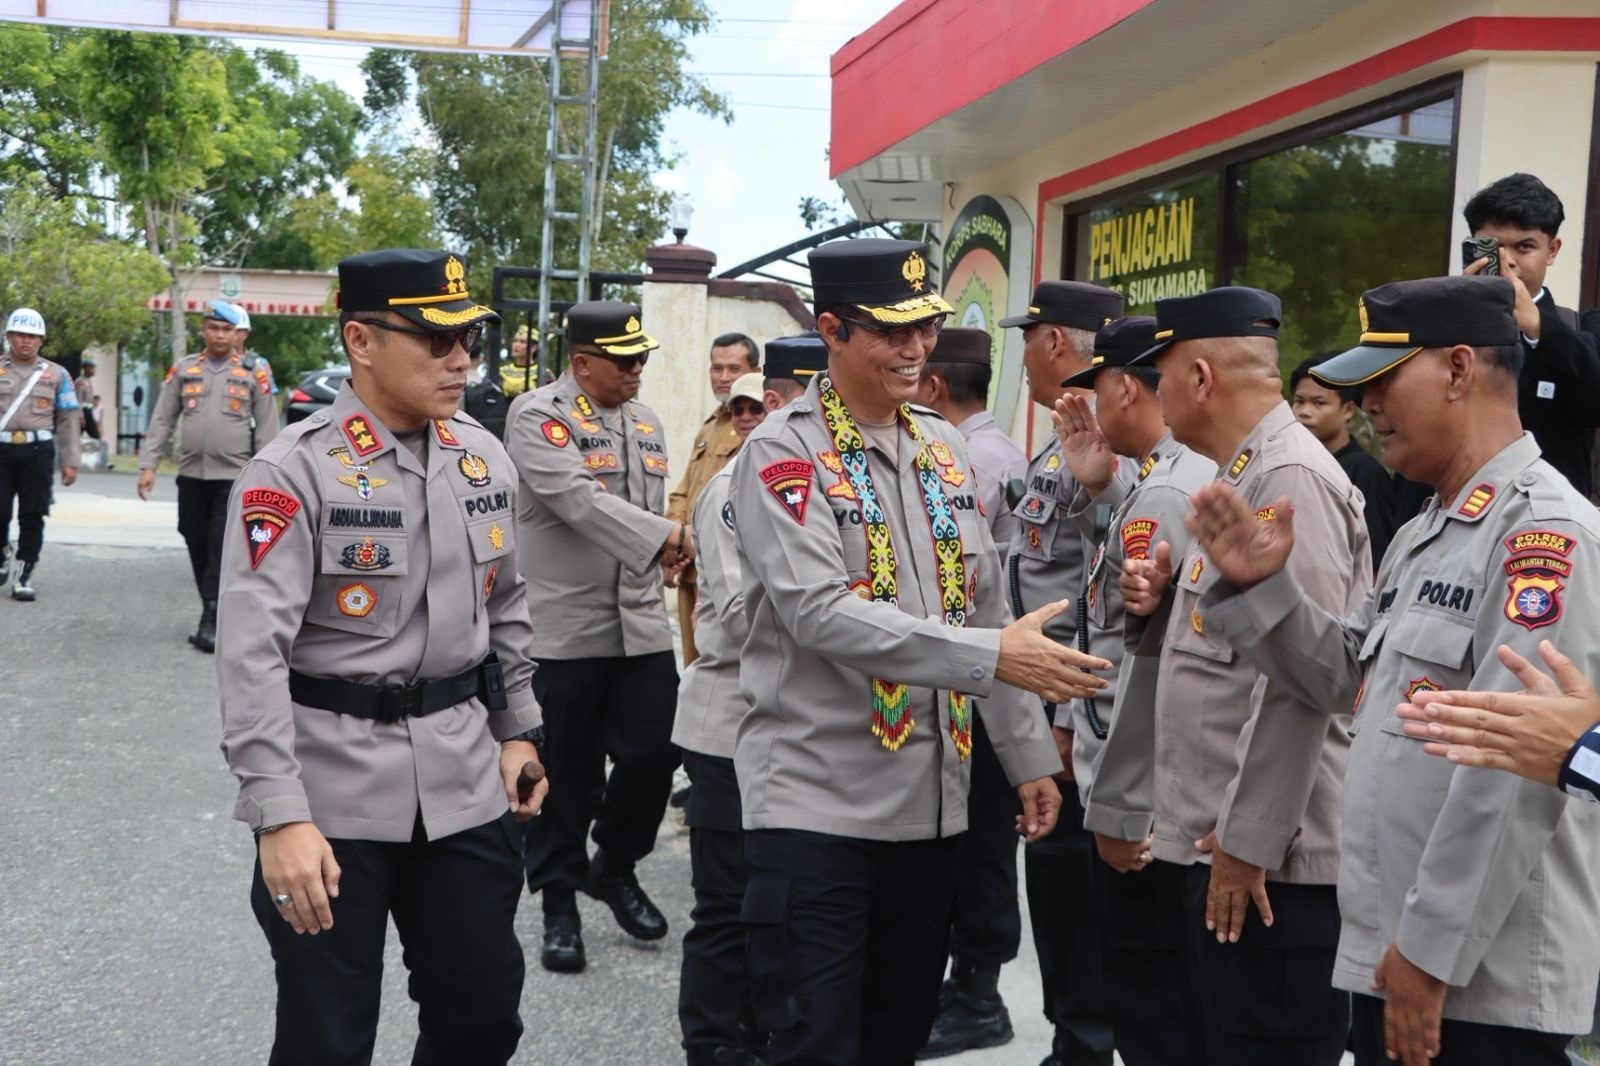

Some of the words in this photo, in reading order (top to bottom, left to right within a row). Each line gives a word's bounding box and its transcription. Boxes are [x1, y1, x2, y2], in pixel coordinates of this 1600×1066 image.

[945, 221, 971, 269] KORPS
[972, 214, 1007, 252] SABHARA
[1090, 197, 1194, 281] PENJAGAAN
[1128, 268, 1207, 306] SUKAMARA
[765, 463, 809, 479] PELOPOR
[1029, 475, 1058, 496] POLRI
[245, 491, 296, 512] PELOPOR
[465, 491, 508, 517] POLRI
[1514, 541, 1566, 552] SUKAMARA
[1516, 533, 1567, 546] POLRES
[1417, 580, 1474, 613] POLRI
